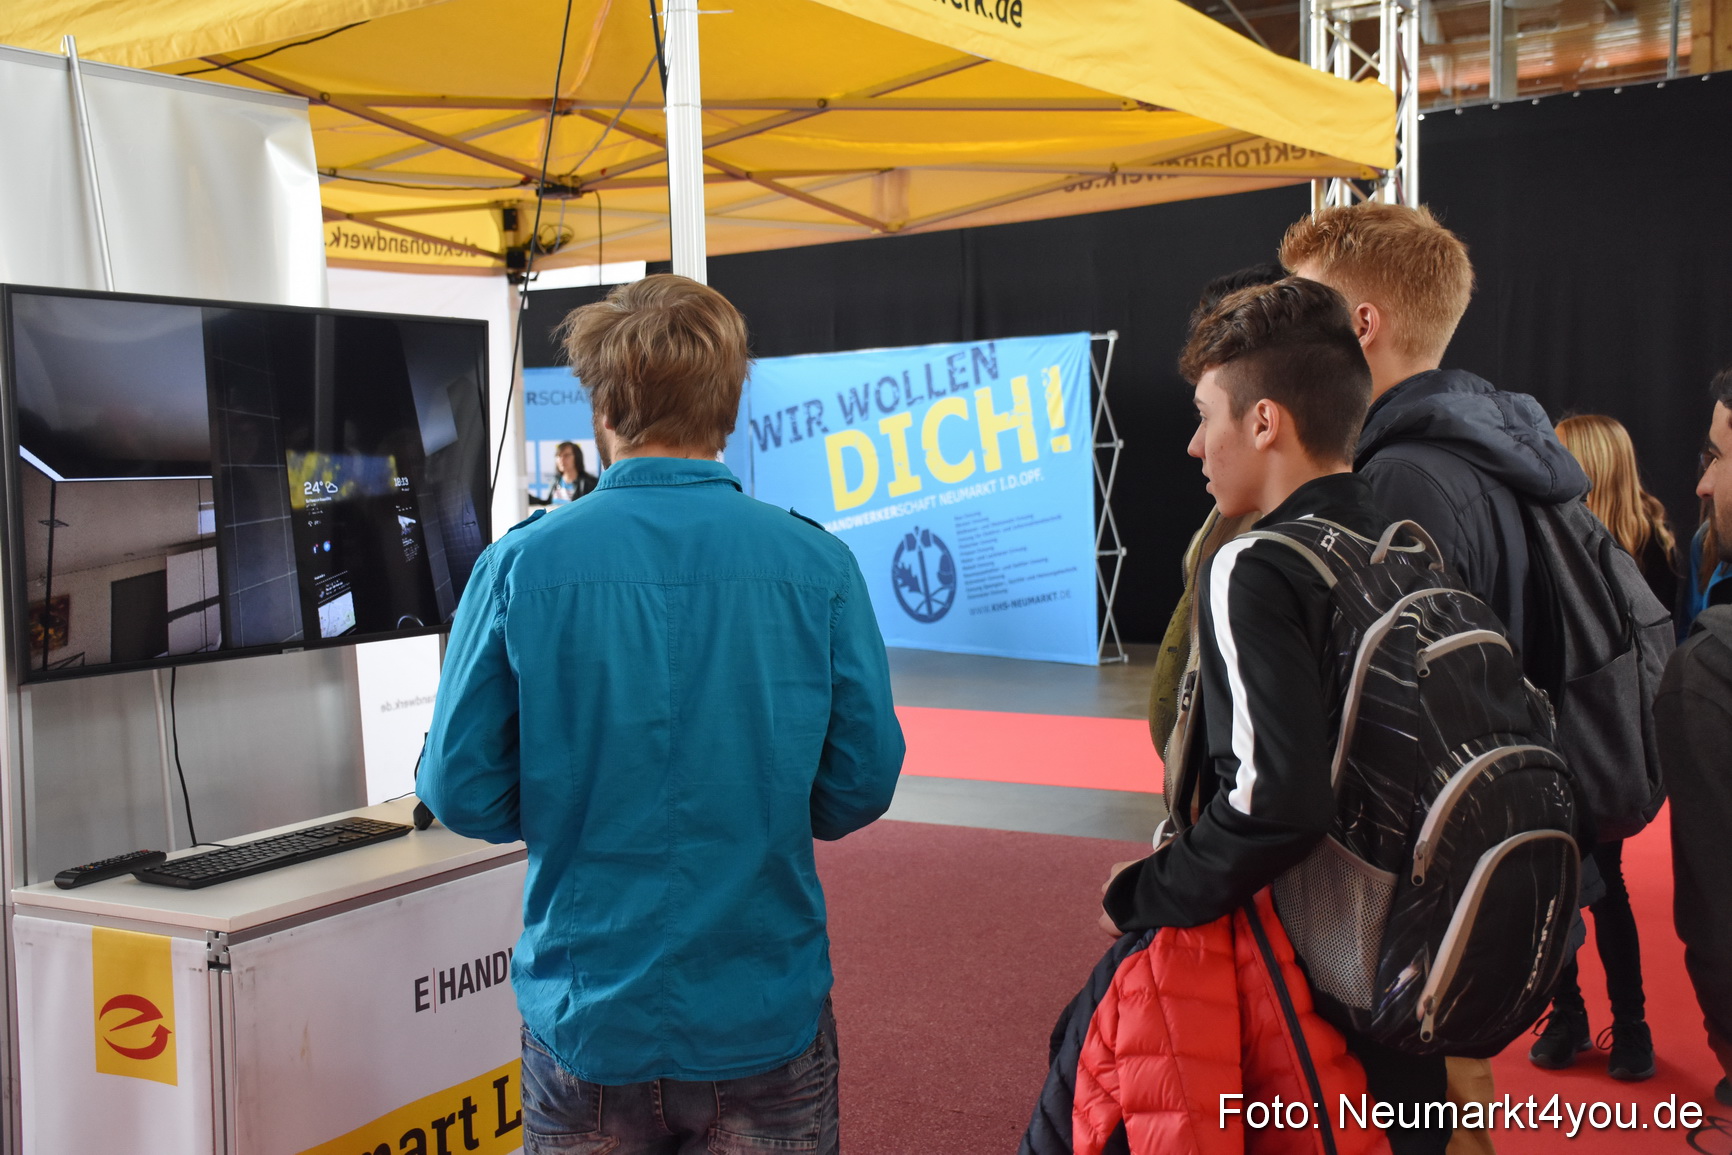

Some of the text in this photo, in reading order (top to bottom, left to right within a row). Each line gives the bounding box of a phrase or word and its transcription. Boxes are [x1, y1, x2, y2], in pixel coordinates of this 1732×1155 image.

[750, 342, 999, 453] WIR WOLLEN
[825, 364, 1071, 512] DICH!
[939, 479, 997, 506] NEUMARKT
[439, 947, 514, 1005] HAND
